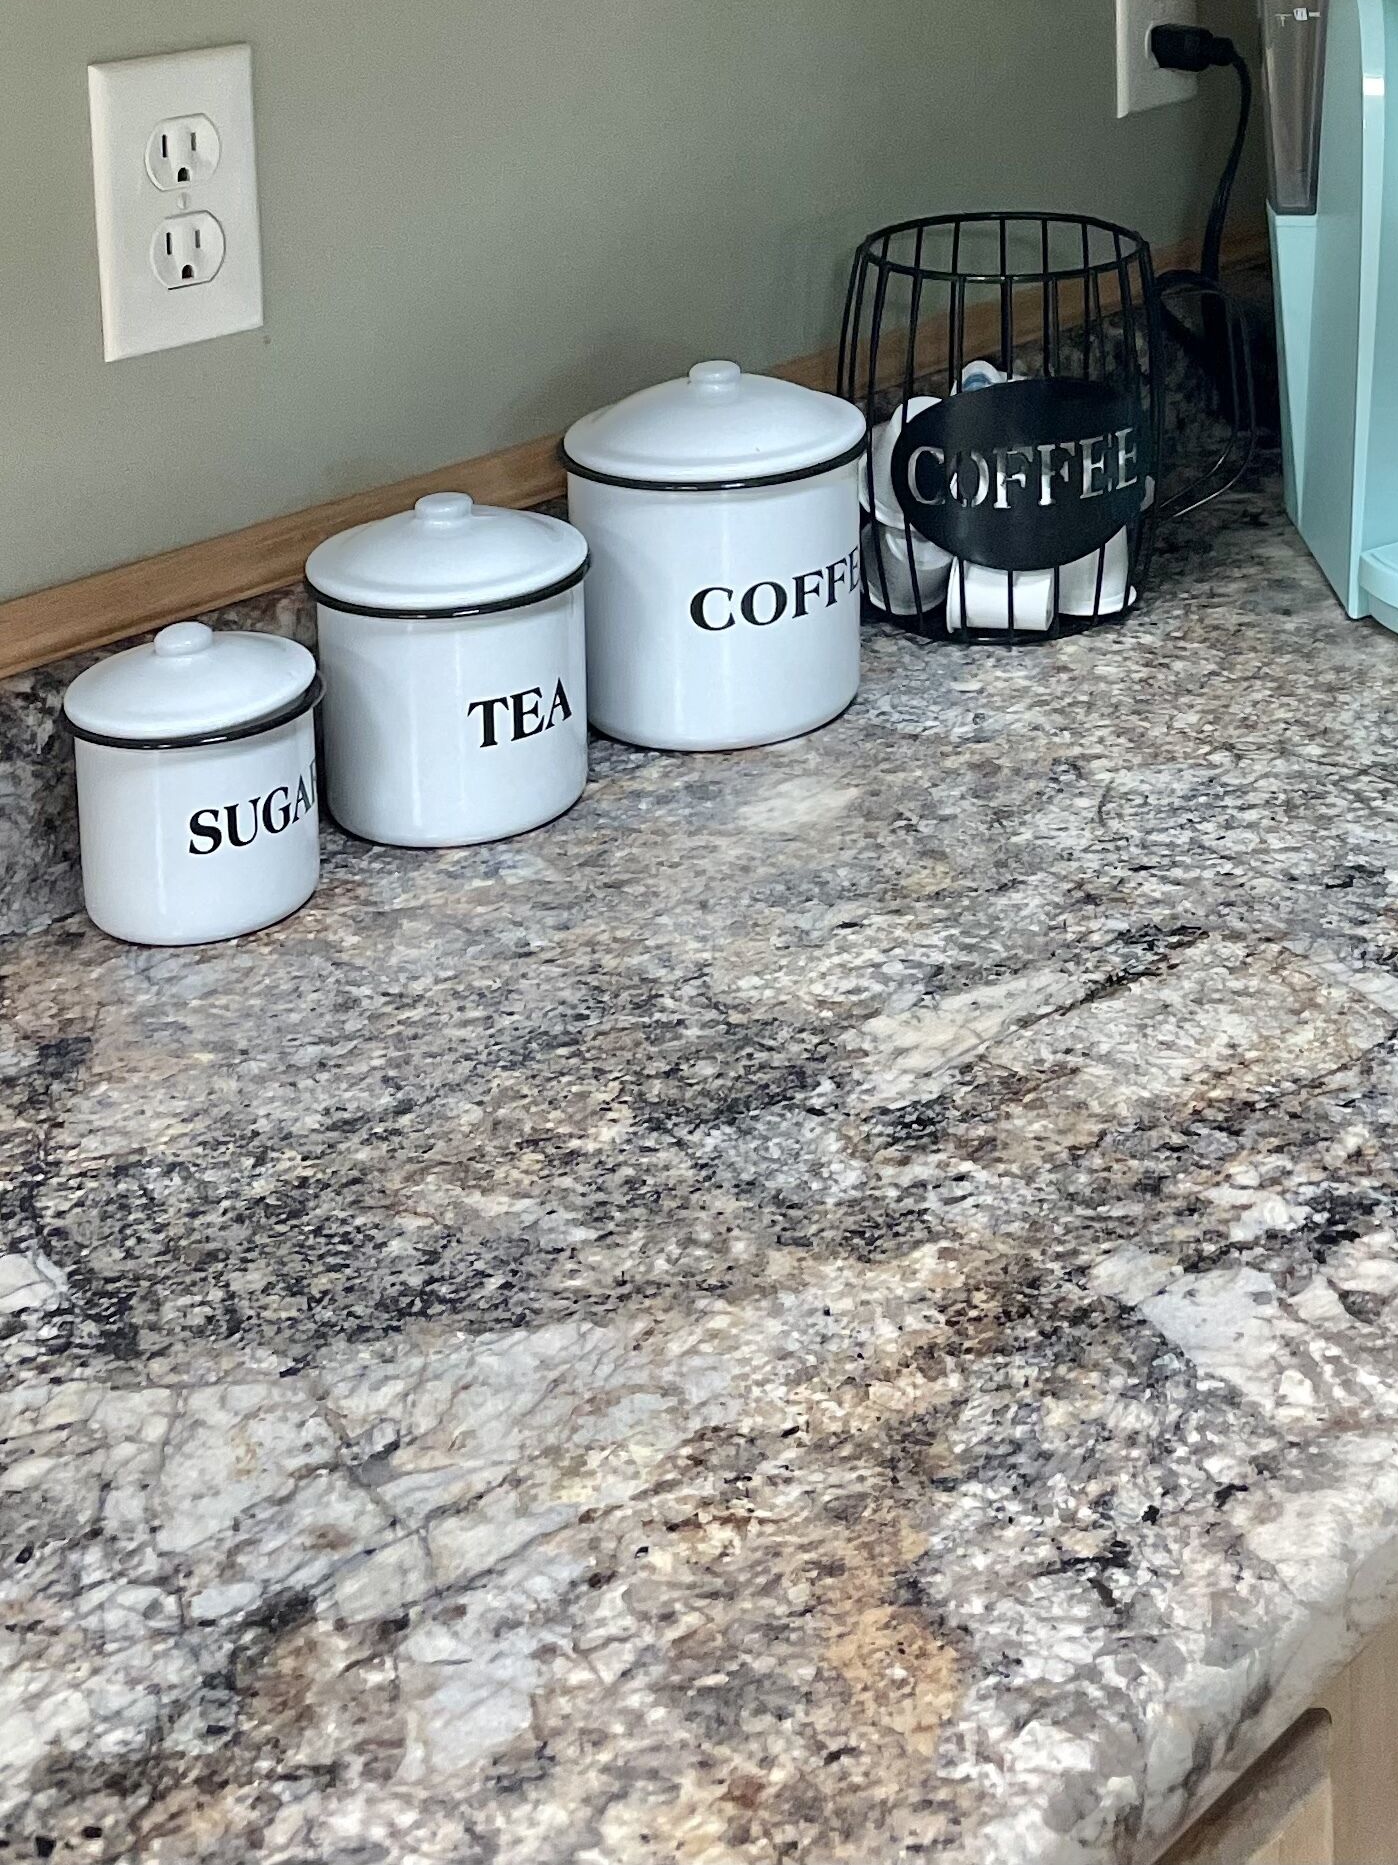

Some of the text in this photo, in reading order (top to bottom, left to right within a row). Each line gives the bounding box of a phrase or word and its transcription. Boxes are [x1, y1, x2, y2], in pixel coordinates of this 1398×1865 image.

[907, 428, 1138, 509] COFFEE
[690, 546, 860, 630] COFFE
[467, 677, 572, 748] TEA
